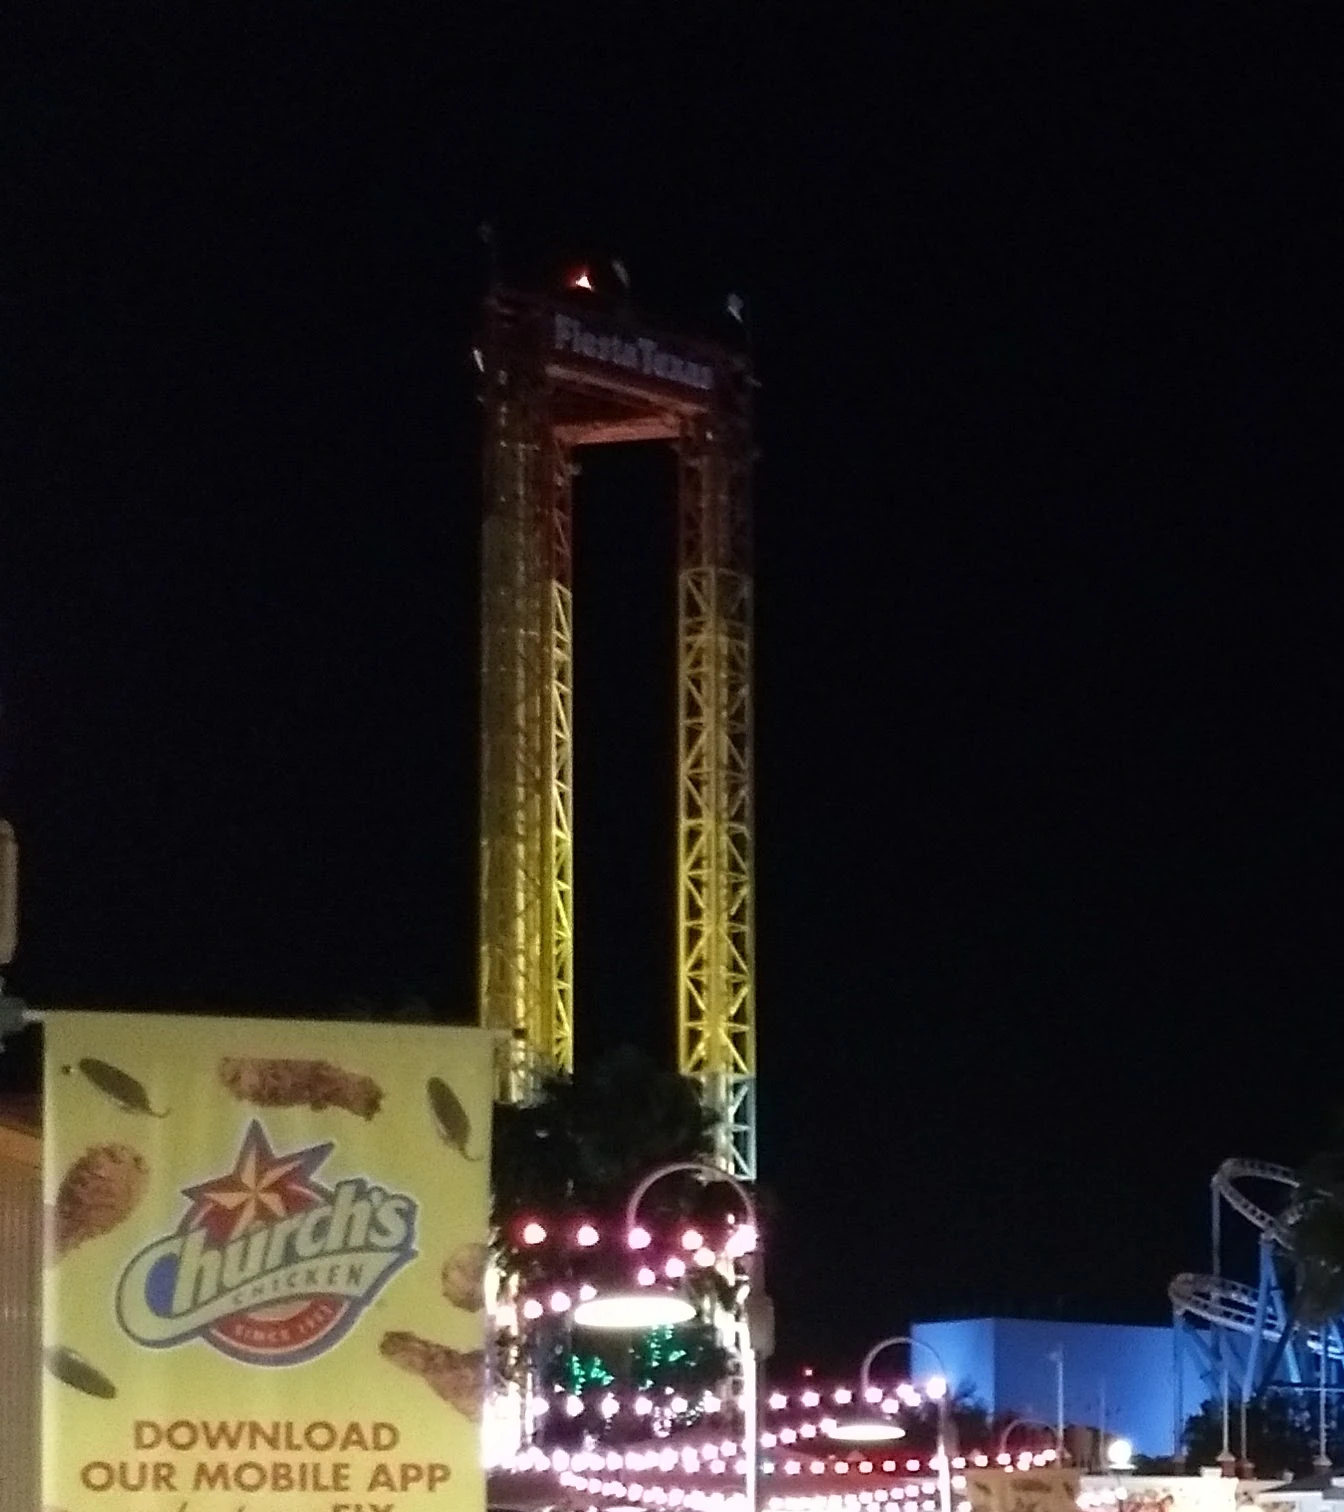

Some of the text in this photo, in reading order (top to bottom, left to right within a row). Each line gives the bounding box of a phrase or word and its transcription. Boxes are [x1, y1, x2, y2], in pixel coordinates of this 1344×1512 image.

[116, 1179, 411, 1346] Church's
[232, 1262, 365, 1305] CHICKEN
[133, 1420, 401, 1451] DOWNLOAD
[80, 1460, 452, 1493] OUR MOBILE APP
